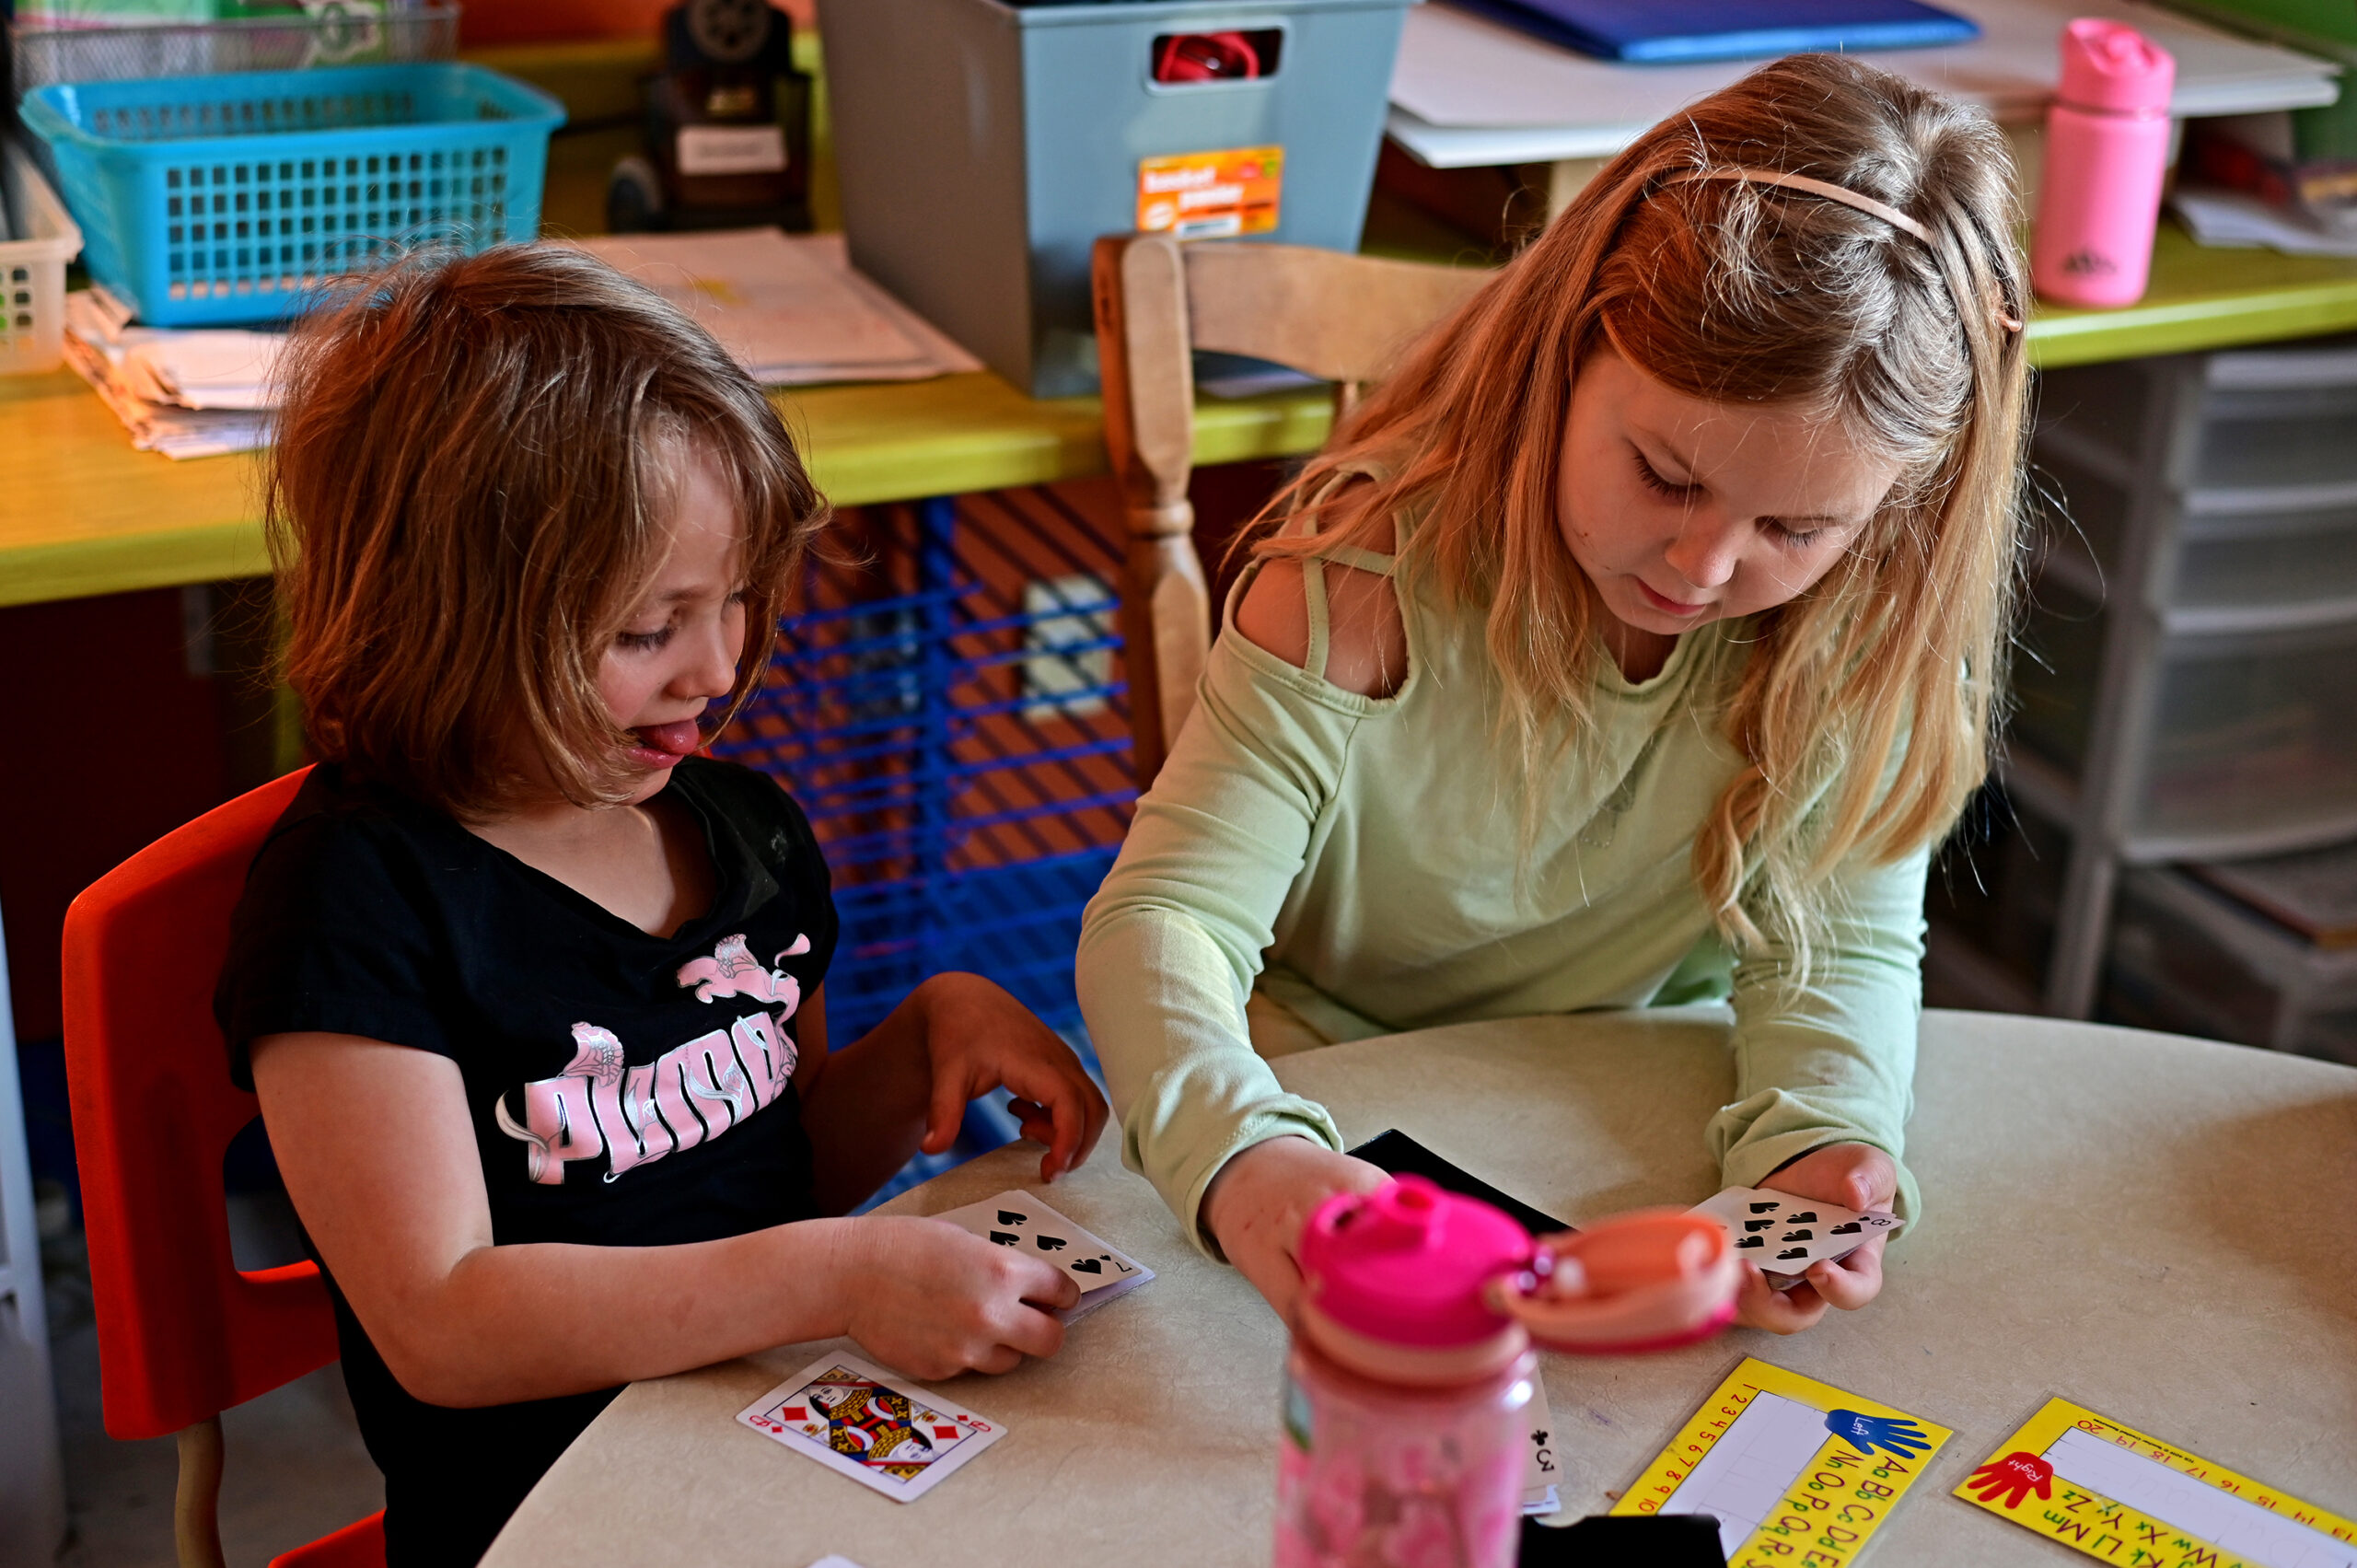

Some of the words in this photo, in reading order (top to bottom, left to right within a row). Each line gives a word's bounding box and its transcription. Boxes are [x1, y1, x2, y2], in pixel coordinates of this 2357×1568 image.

[523, 1011, 795, 1186] PUMA
[1871, 1218, 1891, 1226] 8
[1115, 1260, 1132, 1272] 7
[1731, 1393, 1747, 1403] 2
[1721, 1406, 1737, 1416] 3
[749, 1415, 772, 1427] Q
[969, 1421, 992, 1433] Q
[1710, 1420, 1727, 1428] 4
[1851, 1417, 1874, 1435] Left
[2077, 1420, 2104, 1434] 20
[1699, 1431, 1716, 1442] 5
[2115, 1435, 2137, 1448] 19
[1688, 1445, 1703, 1453] 6
[1536, 1448, 1554, 1472] 3
[1678, 1458, 1694, 1467] 7
[2150, 1450, 2171, 1463] 18
[1666, 1470, 1682, 1481] 8
[2008, 1459, 2043, 1482] Right
[2185, 1467, 2207, 1479] 17
[1653, 1485, 1671, 1493] 9
[2220, 1480, 2240, 1493] 16
[1638, 1498, 1658, 1512] 10
[2255, 1495, 2277, 1509] 15
